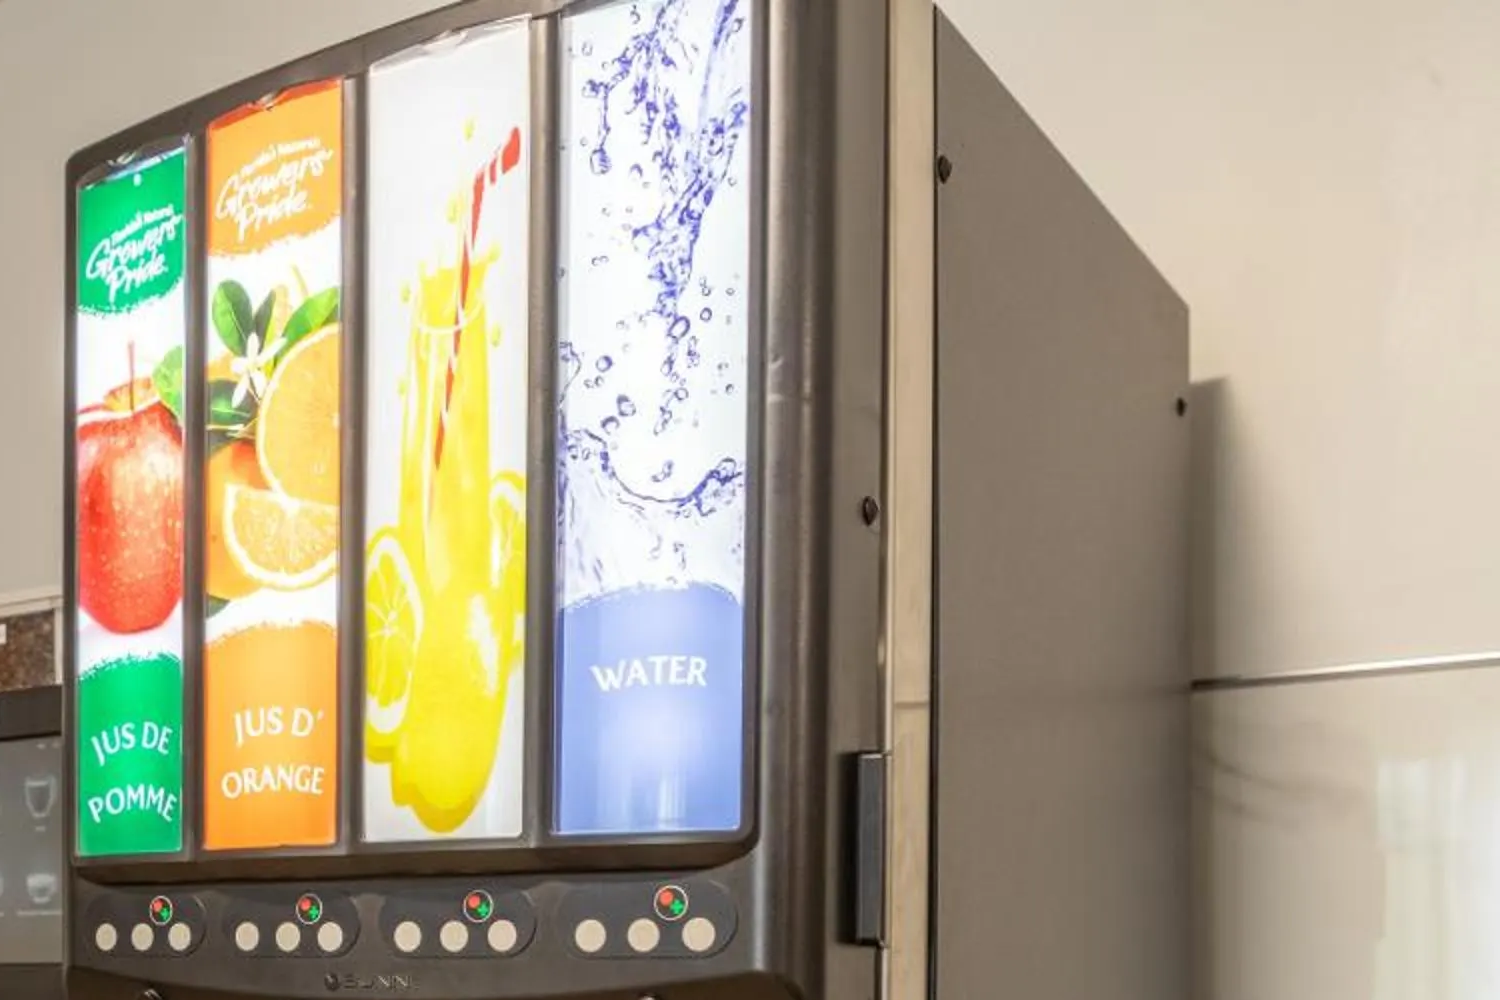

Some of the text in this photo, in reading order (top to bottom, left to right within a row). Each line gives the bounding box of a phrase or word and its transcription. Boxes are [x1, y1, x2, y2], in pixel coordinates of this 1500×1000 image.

[106, 252, 168, 304] Pride
[589, 654, 708, 692] WATER
[91, 721, 174, 767] JUS DE
[233, 706, 284, 749] JUS
[221, 764, 325, 799] ORANGE
[87, 783, 178, 823] POMME
